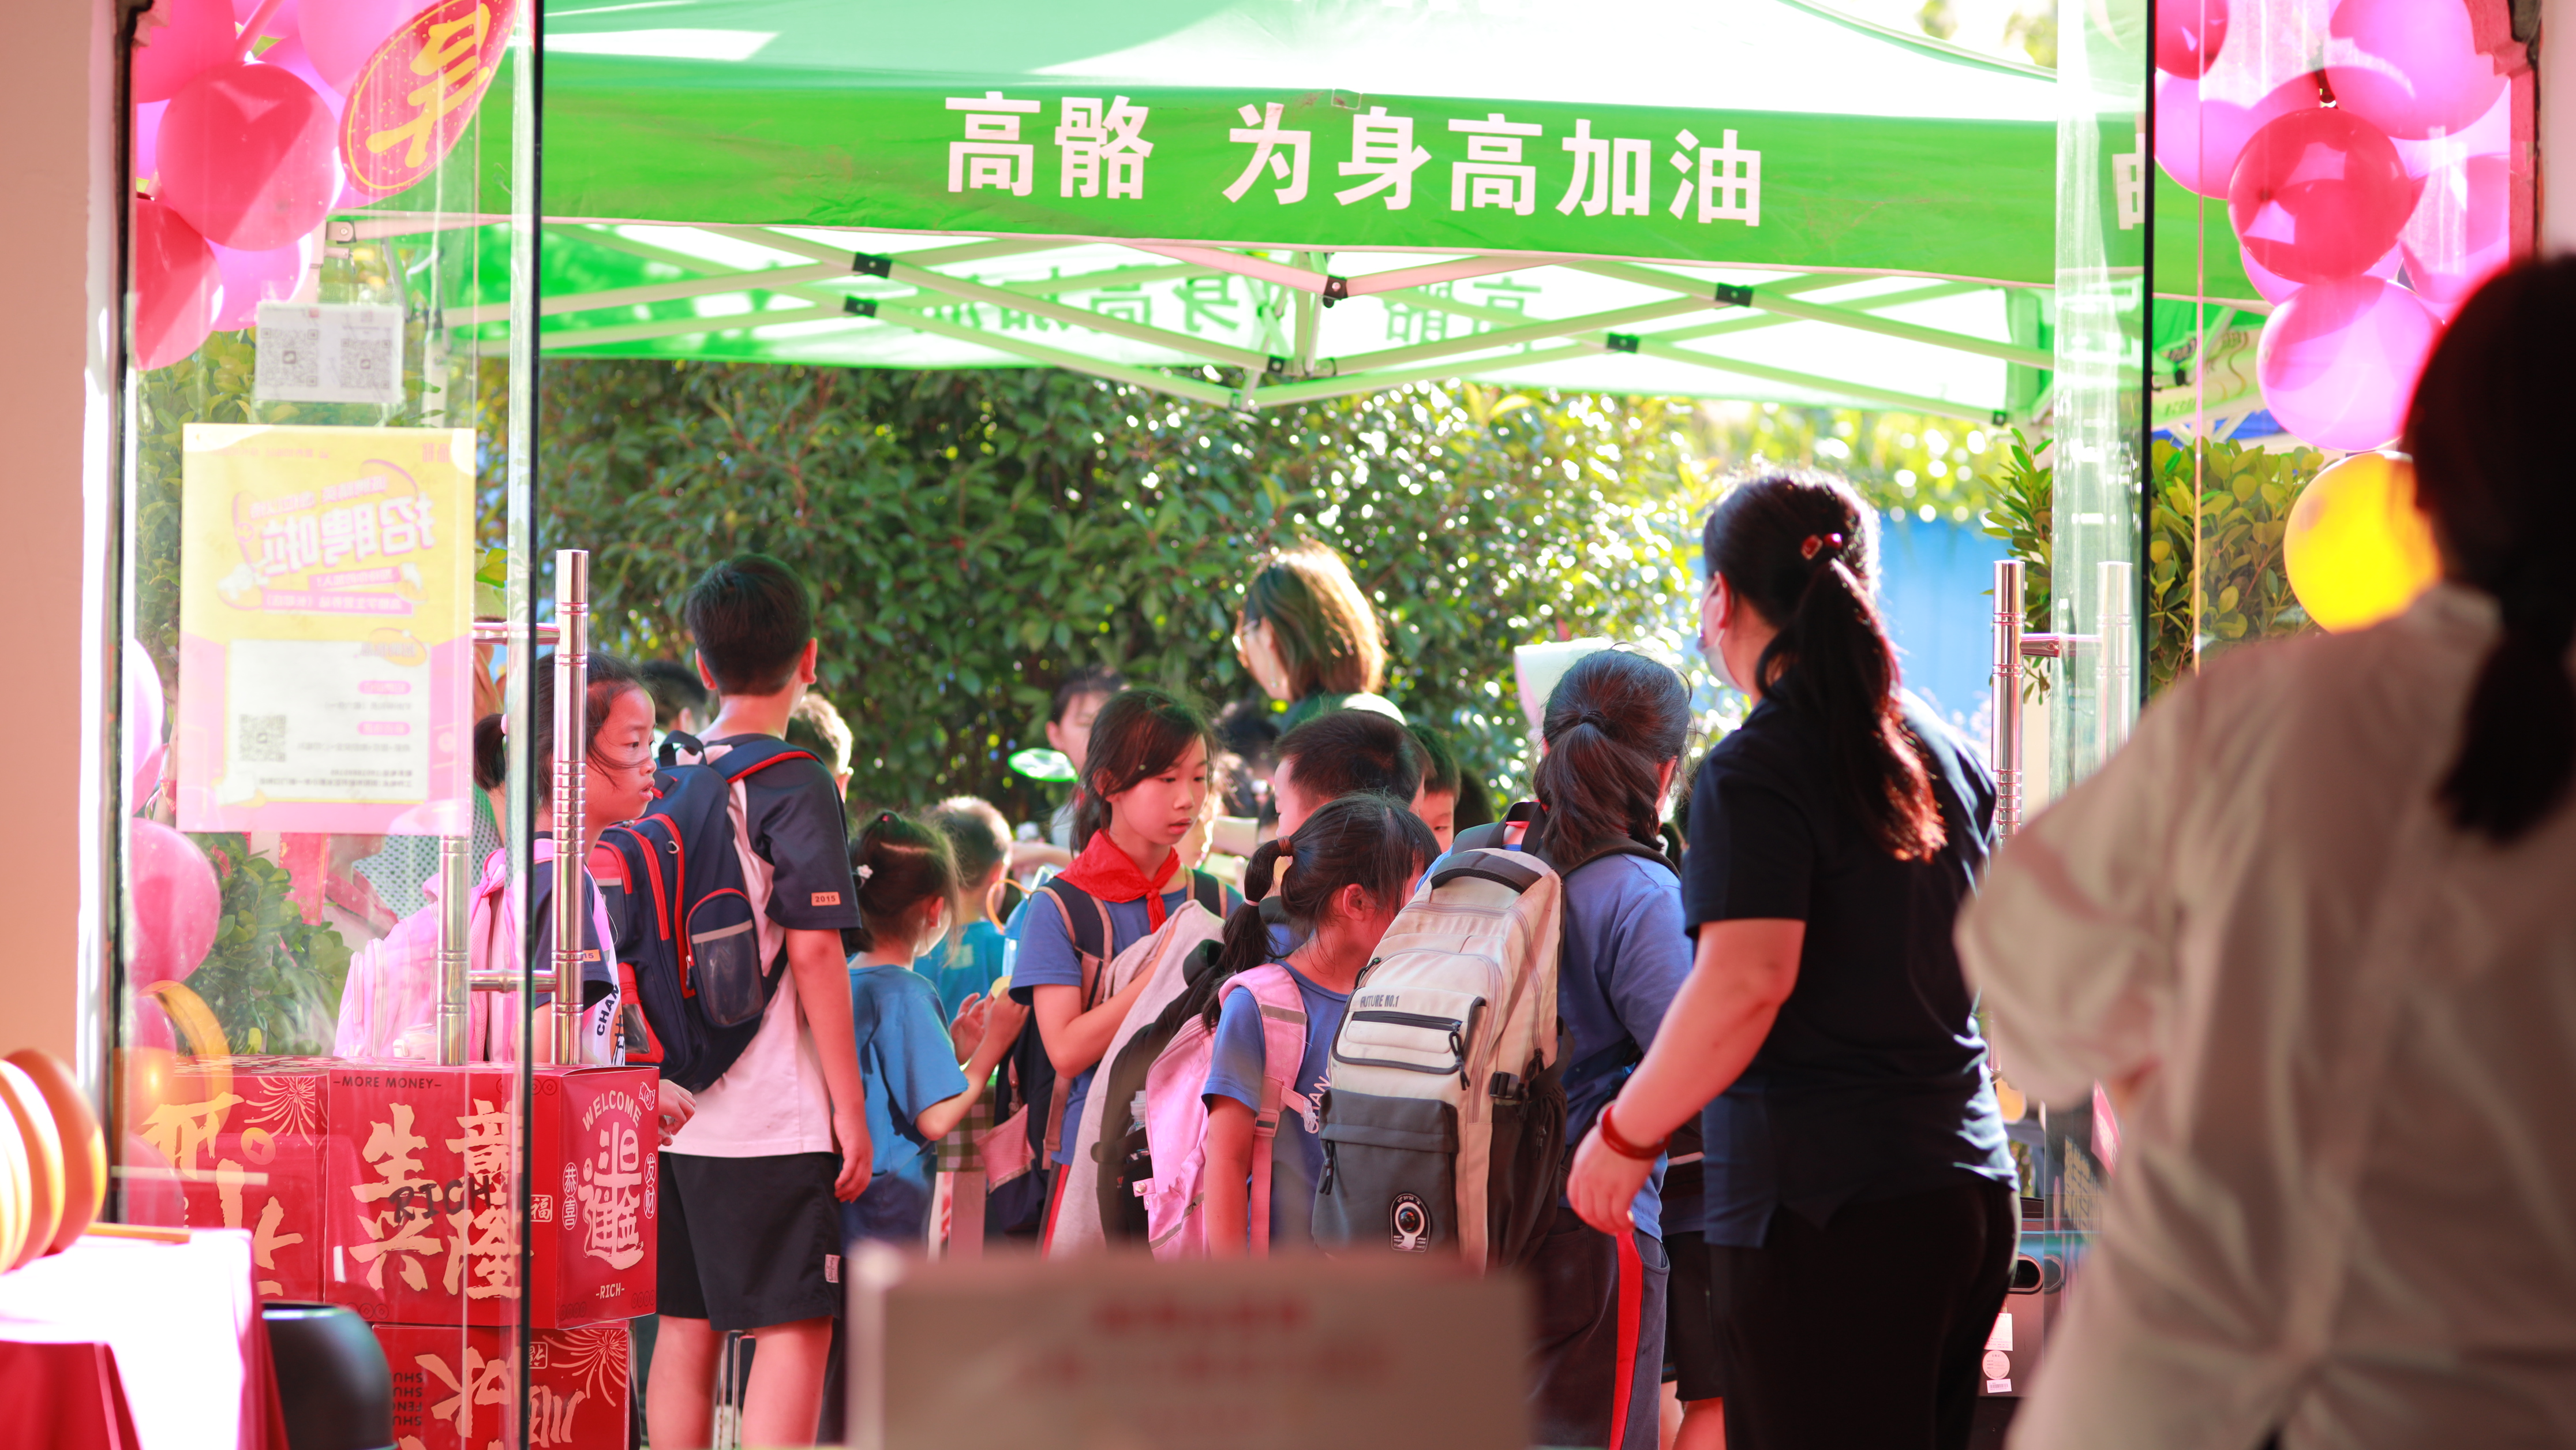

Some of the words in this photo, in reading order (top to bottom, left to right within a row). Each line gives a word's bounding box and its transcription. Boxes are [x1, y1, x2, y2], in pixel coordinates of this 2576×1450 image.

[945, 91, 1154, 200] 高骼
[1222, 102, 1761, 227] 为身高加油
[1360, 995, 1384, 1007] FUTURE
[1384, 995, 1399, 1007] NO.1
[582, 1090, 642, 1132] WELCOME
[388, 1174, 491, 1224] RICH
[564, 1165, 576, 1228] 恭喜
[645, 1156, 656, 1217] 发财
[531, 1197, 551, 1220] 福
[393, 1388, 422, 1397] SHU
[393, 1402, 422, 1412] FEN
[393, 1417, 422, 1426] SHU
